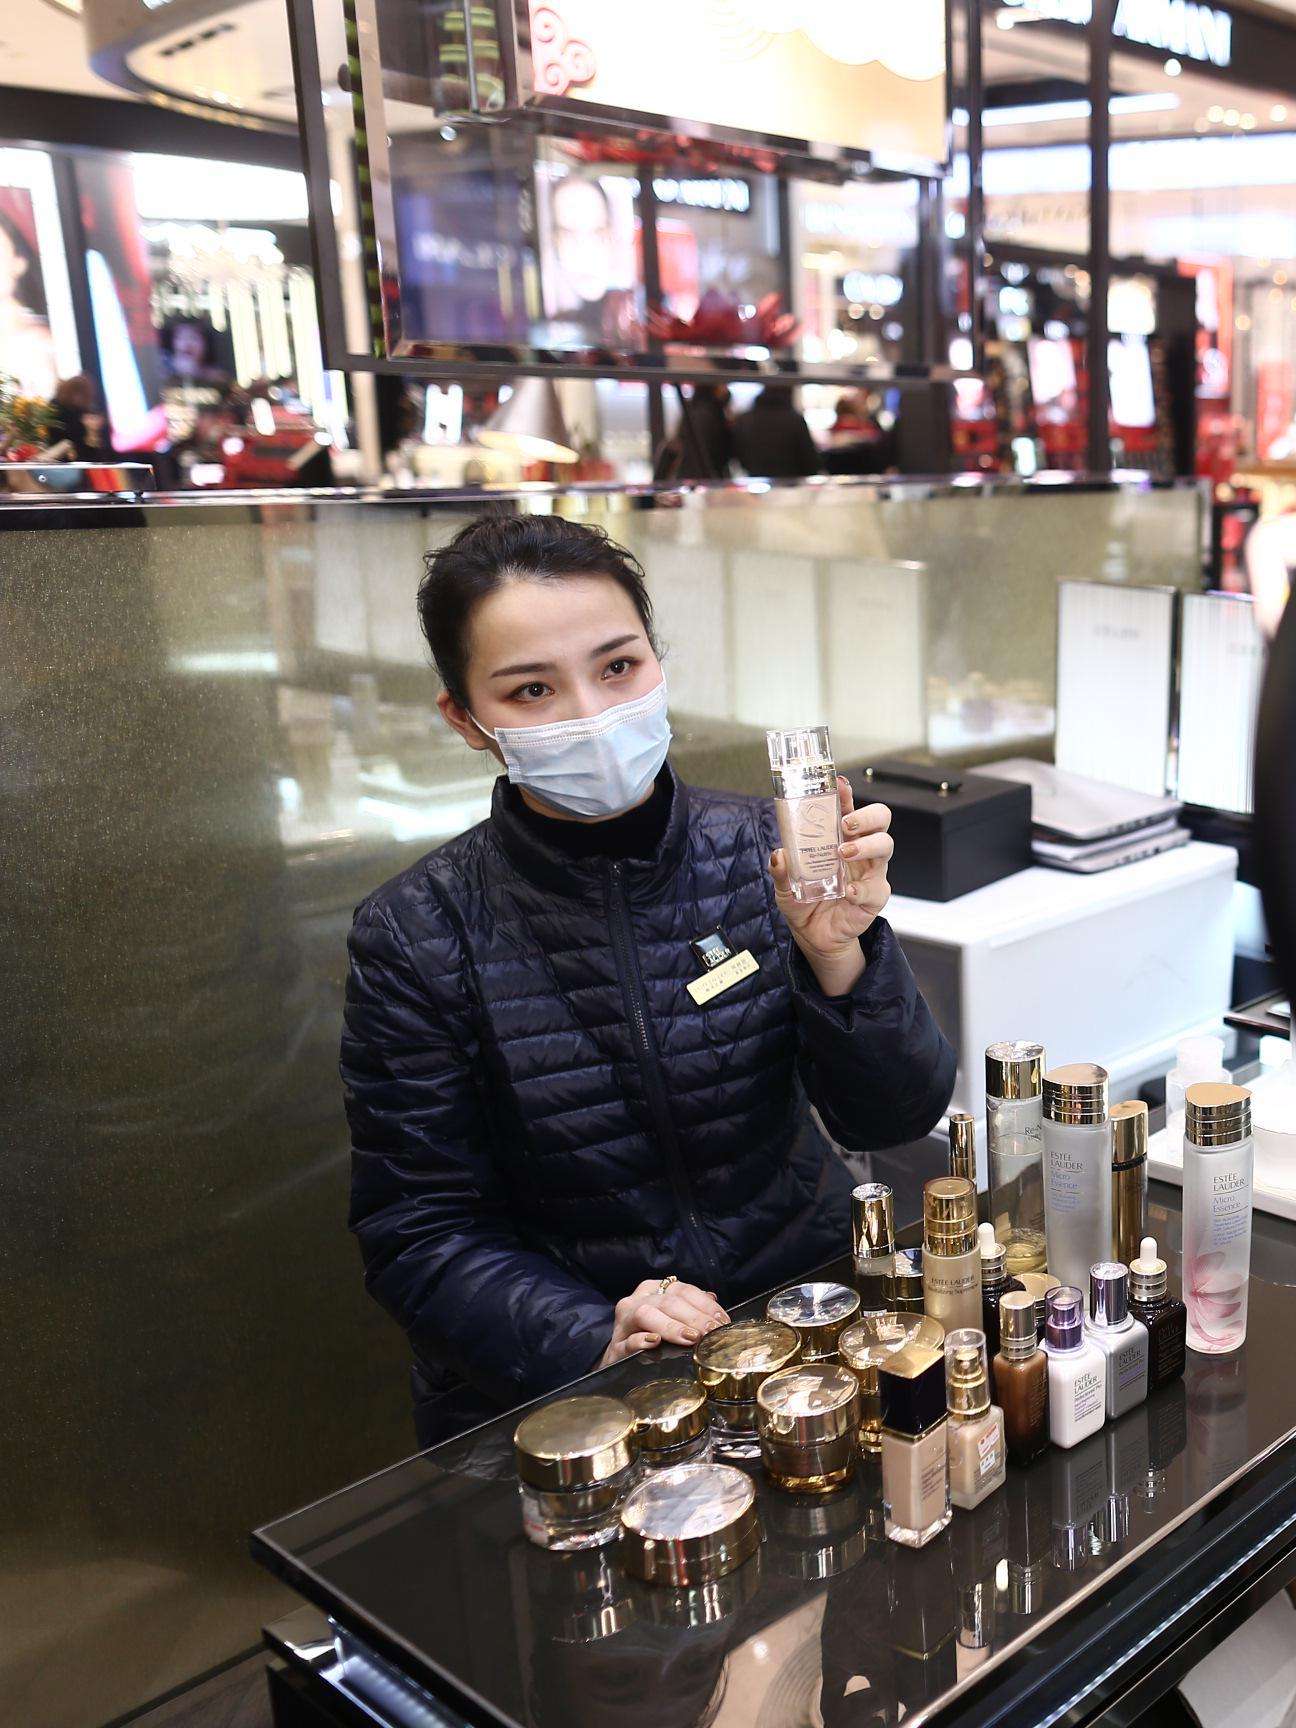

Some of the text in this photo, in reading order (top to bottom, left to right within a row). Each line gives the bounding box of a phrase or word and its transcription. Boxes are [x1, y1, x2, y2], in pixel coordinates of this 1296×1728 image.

[1213, 1178, 1245, 1192] LAUDER
[1213, 1196, 1235, 1204] Micro
[1213, 1202, 1241, 1213] Essence
[1074, 1375, 1098, 1394] LAUDER
